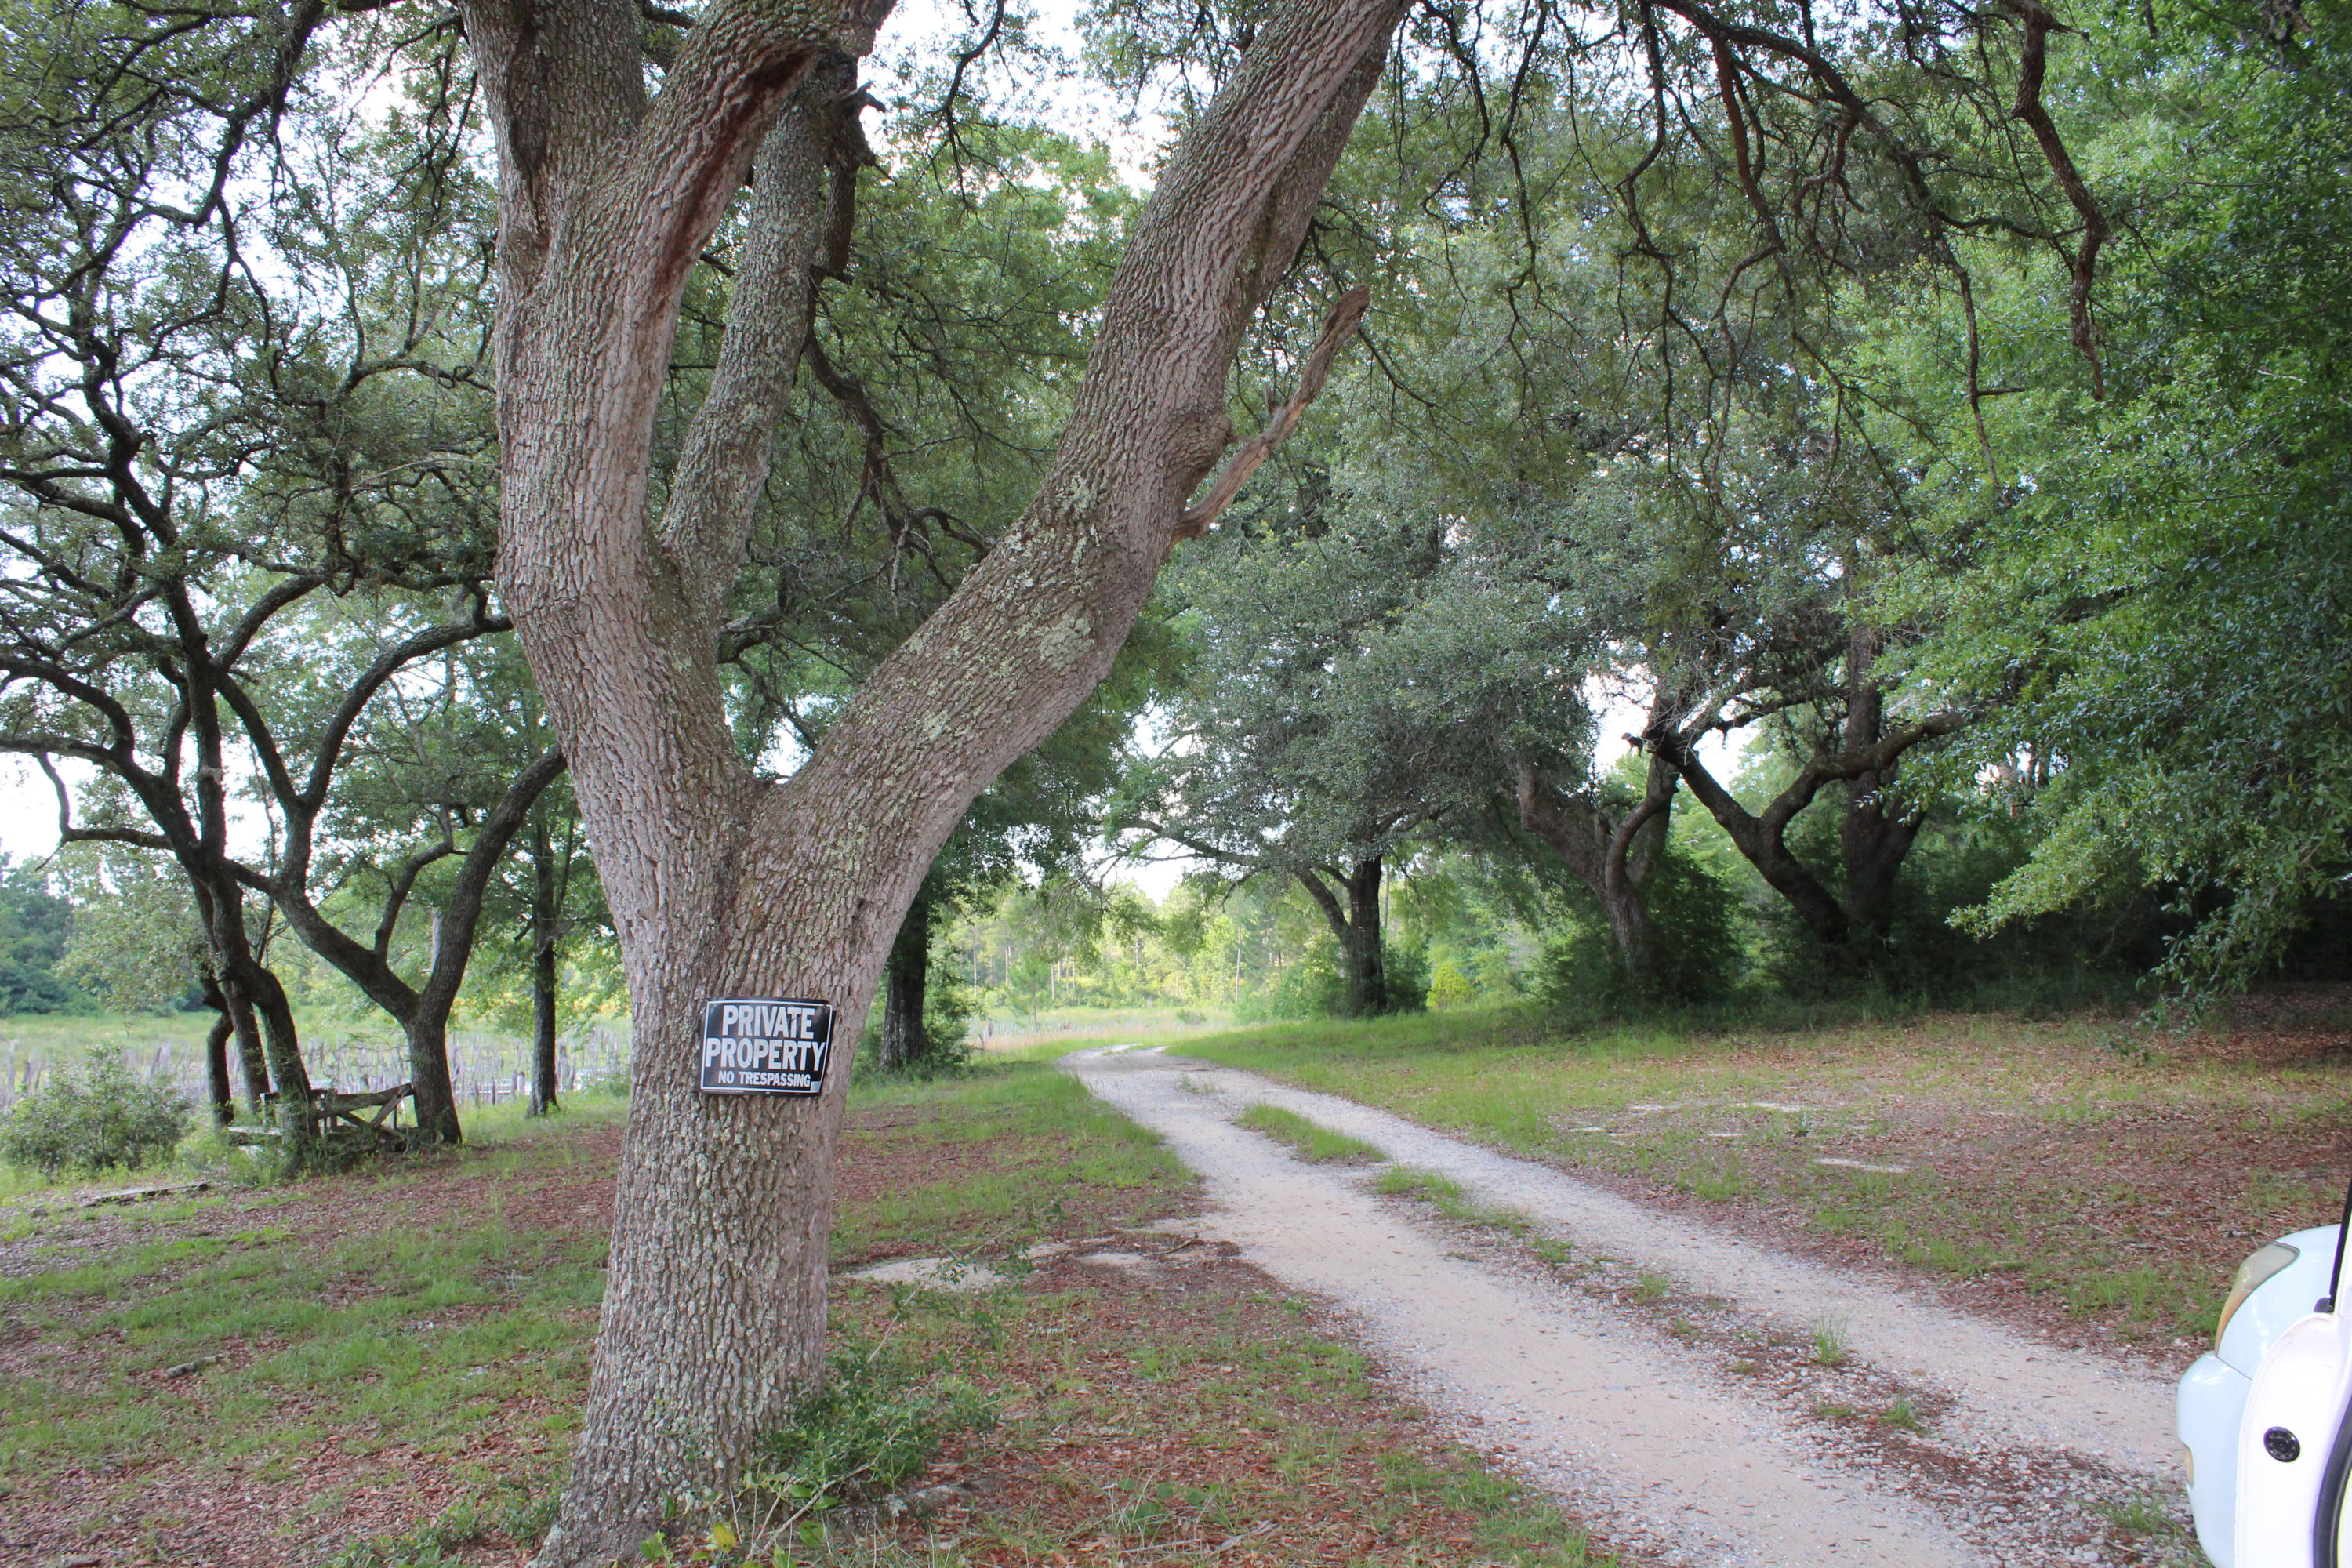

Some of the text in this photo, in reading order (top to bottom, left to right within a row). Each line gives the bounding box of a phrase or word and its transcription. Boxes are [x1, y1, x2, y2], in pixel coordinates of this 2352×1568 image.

[722, 1005, 815, 1039] PRIVATE
[706, 1037, 826, 1071] PROPERTY
[718, 1070, 811, 1087] NO TRESPASSING
